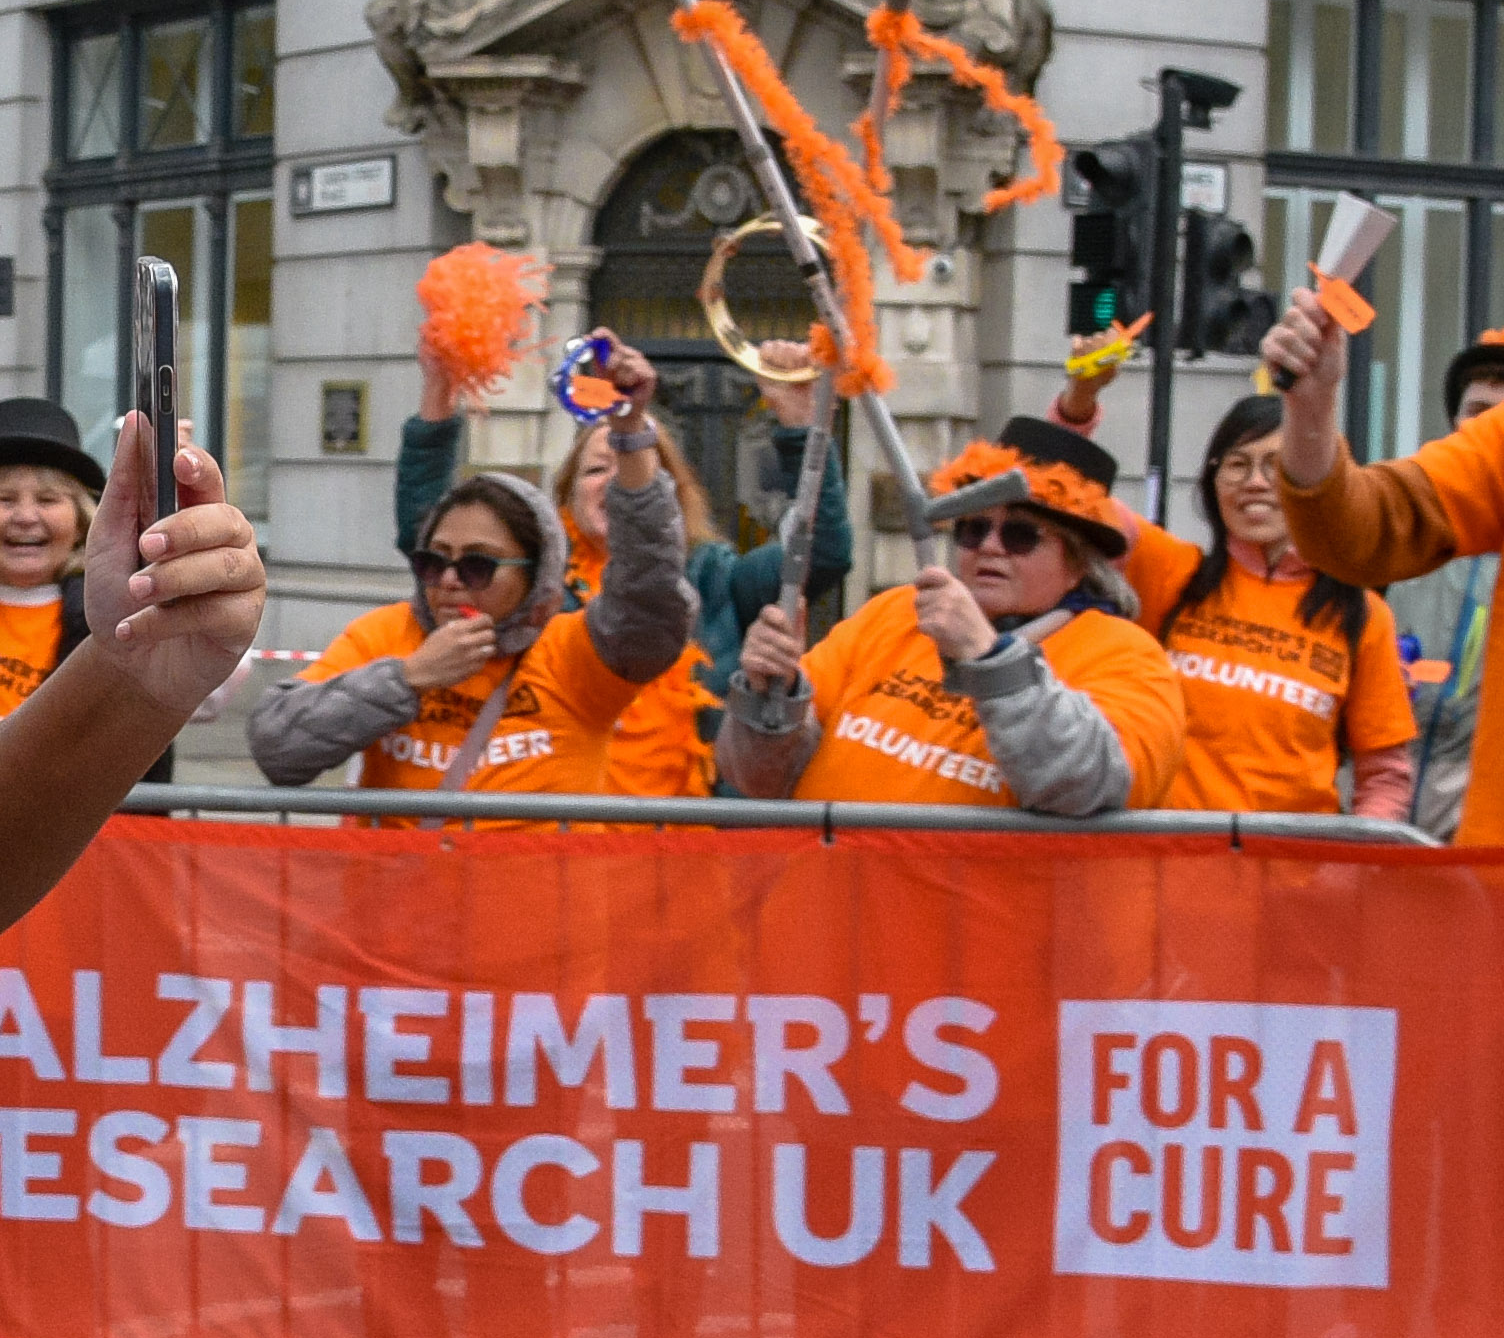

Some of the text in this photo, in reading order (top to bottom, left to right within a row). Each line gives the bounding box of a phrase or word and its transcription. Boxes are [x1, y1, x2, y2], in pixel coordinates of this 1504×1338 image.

[1166, 649, 1337, 721] VOLUNTEER
[1091, 1032, 1357, 1137] FOR A
[771, 1141, 998, 1273] UK
[1088, 1140, 1356, 1256] CURE
